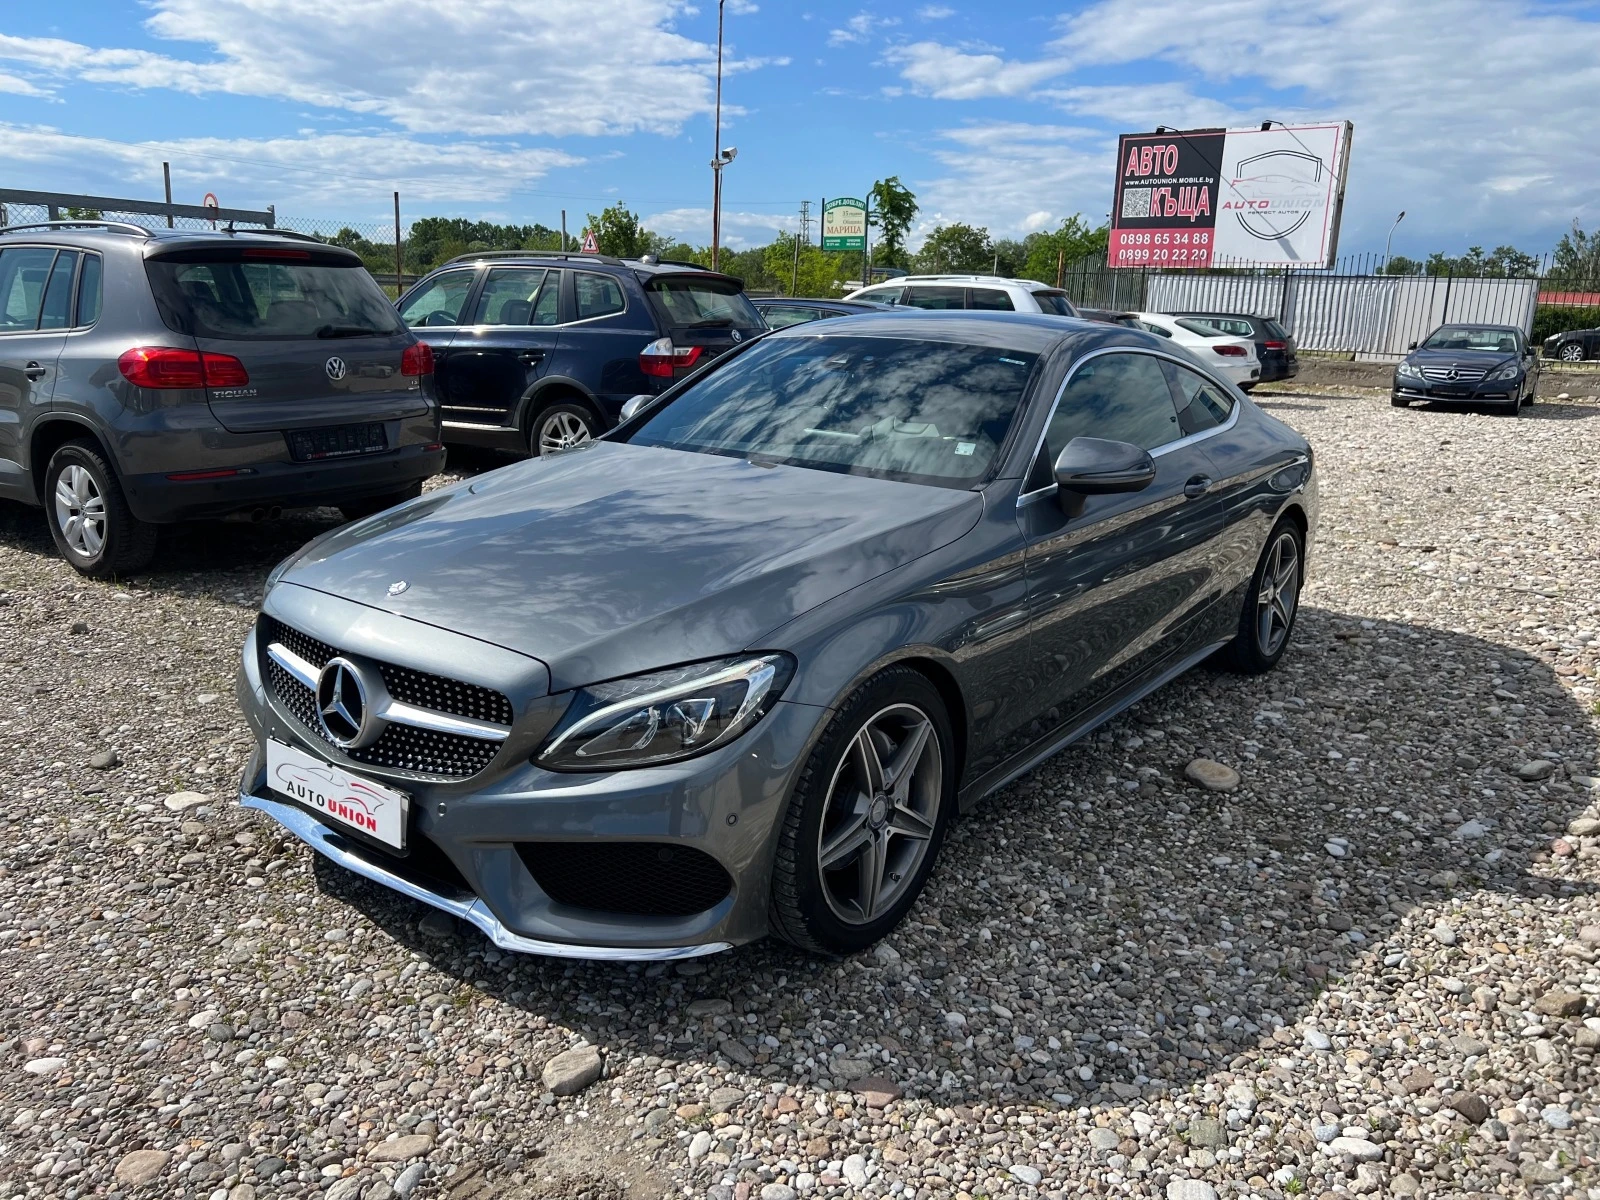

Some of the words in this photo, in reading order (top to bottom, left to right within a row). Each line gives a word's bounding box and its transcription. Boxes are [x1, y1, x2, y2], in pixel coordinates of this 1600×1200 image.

[1125, 144, 1178, 176] АВТО
[1125, 177, 1214, 185] www.AUTOUNION.MOBILE.bg
[1150, 186, 1210, 222] КЪЩА
[827, 226, 862, 234] МАРИЦА
[1120, 233, 1151, 245] 0898
[1154, 233, 1170, 245] 65
[1173, 233, 1189, 244] 34
[1192, 233, 1209, 244] 88
[1119, 249, 1150, 260] 0899
[1153, 249, 1169, 260] 20
[1172, 249, 1188, 260] 22
[1191, 249, 1207, 260] 20
[286, 780, 325, 807] AUTO
[328, 799, 377, 832] UNION
